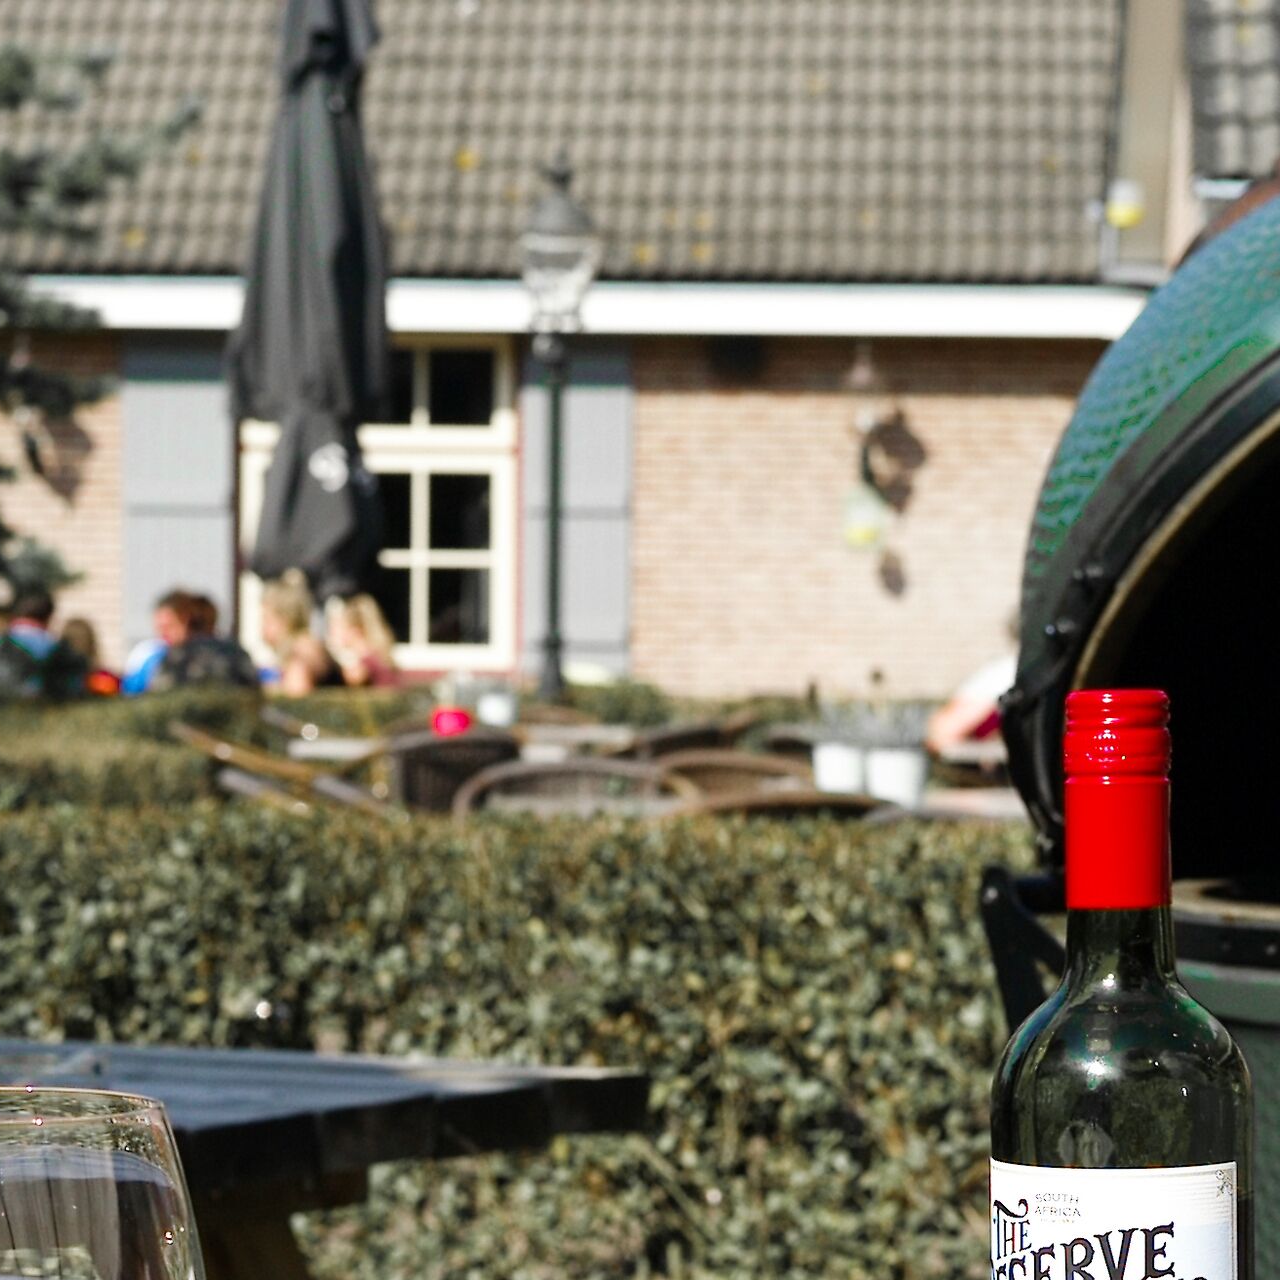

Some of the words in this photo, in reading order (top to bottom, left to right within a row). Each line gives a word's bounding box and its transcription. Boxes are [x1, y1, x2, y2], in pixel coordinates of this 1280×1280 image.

[1034, 1192, 1079, 1204] SOUTH
[1034, 1205, 1081, 1218] AFRICA
[993, 1198, 1031, 1260] THE
